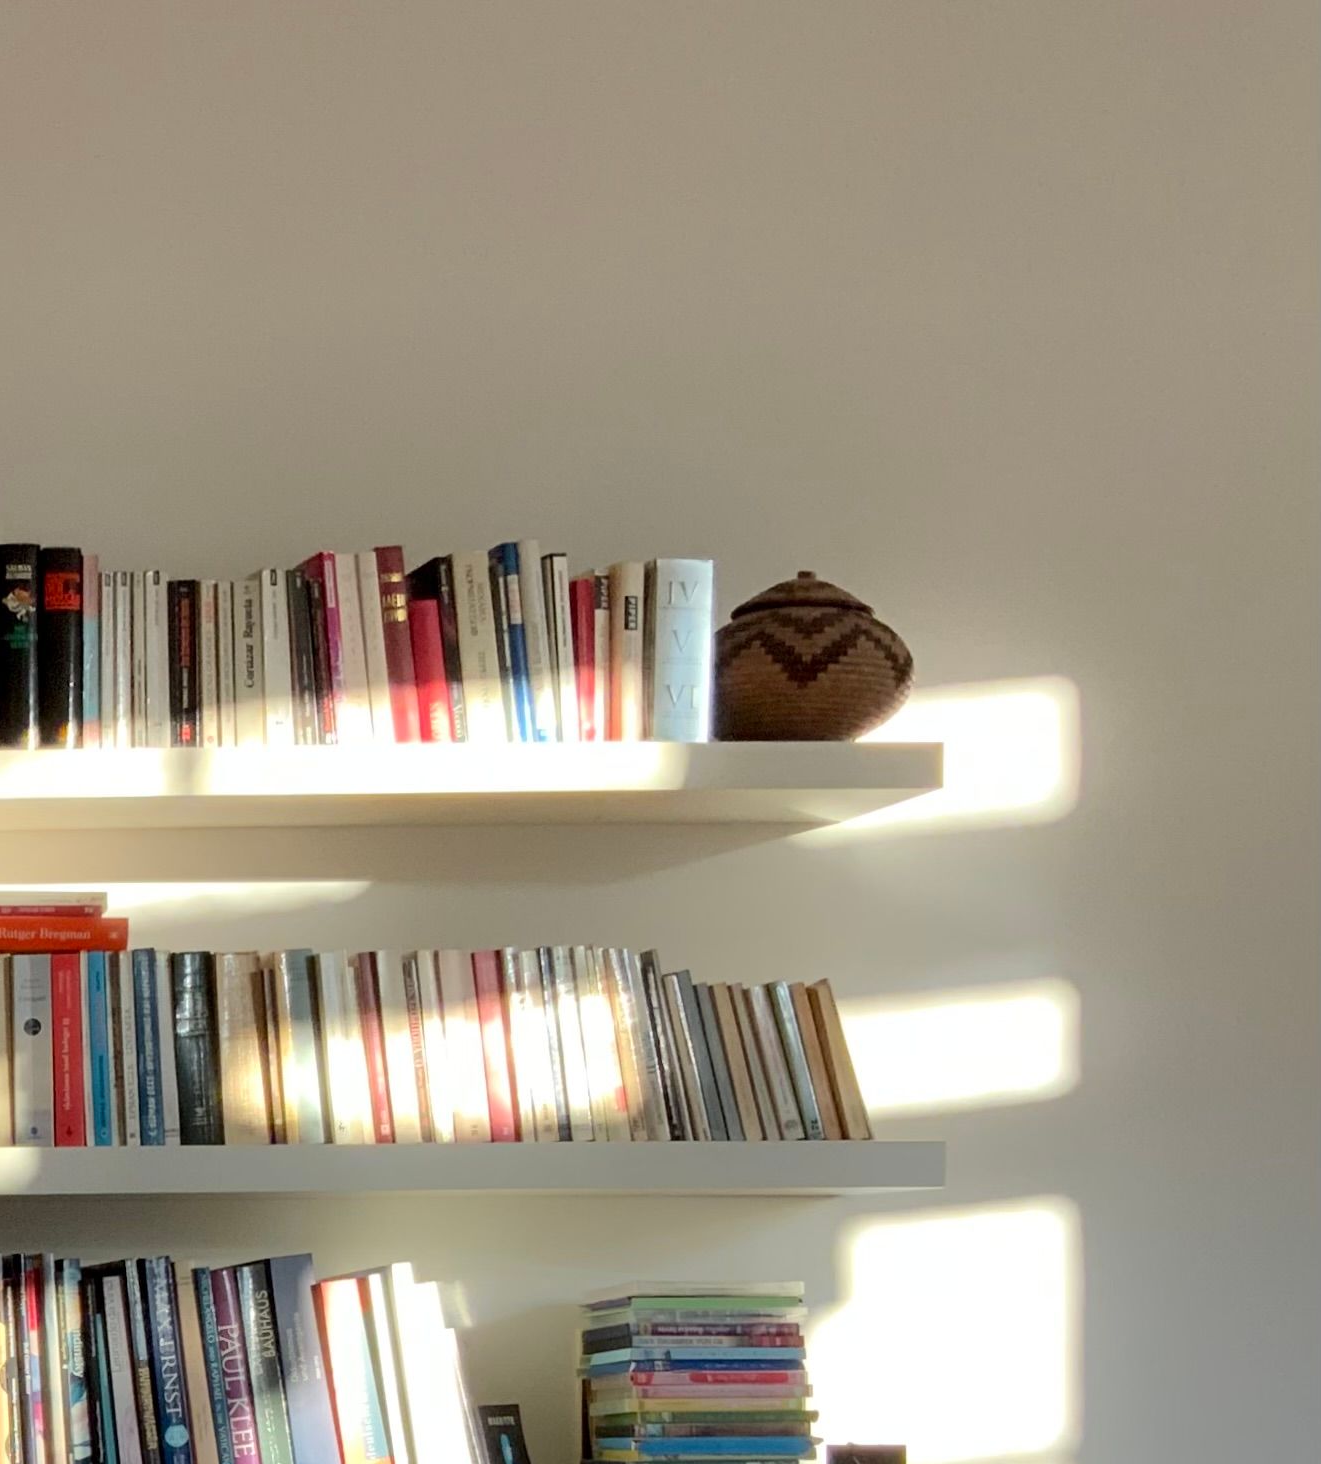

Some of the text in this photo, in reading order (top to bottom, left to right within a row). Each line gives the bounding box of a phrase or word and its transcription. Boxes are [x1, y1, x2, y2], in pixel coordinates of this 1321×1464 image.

[627, 597, 638, 629] PIPER
[38, 926, 92, 942] Bregman
[255, 1290, 275, 1358] BAUHAUS
[158, 1337, 184, 1418] ERNST
[218, 1323, 256, 1459] PAUL KLEE
